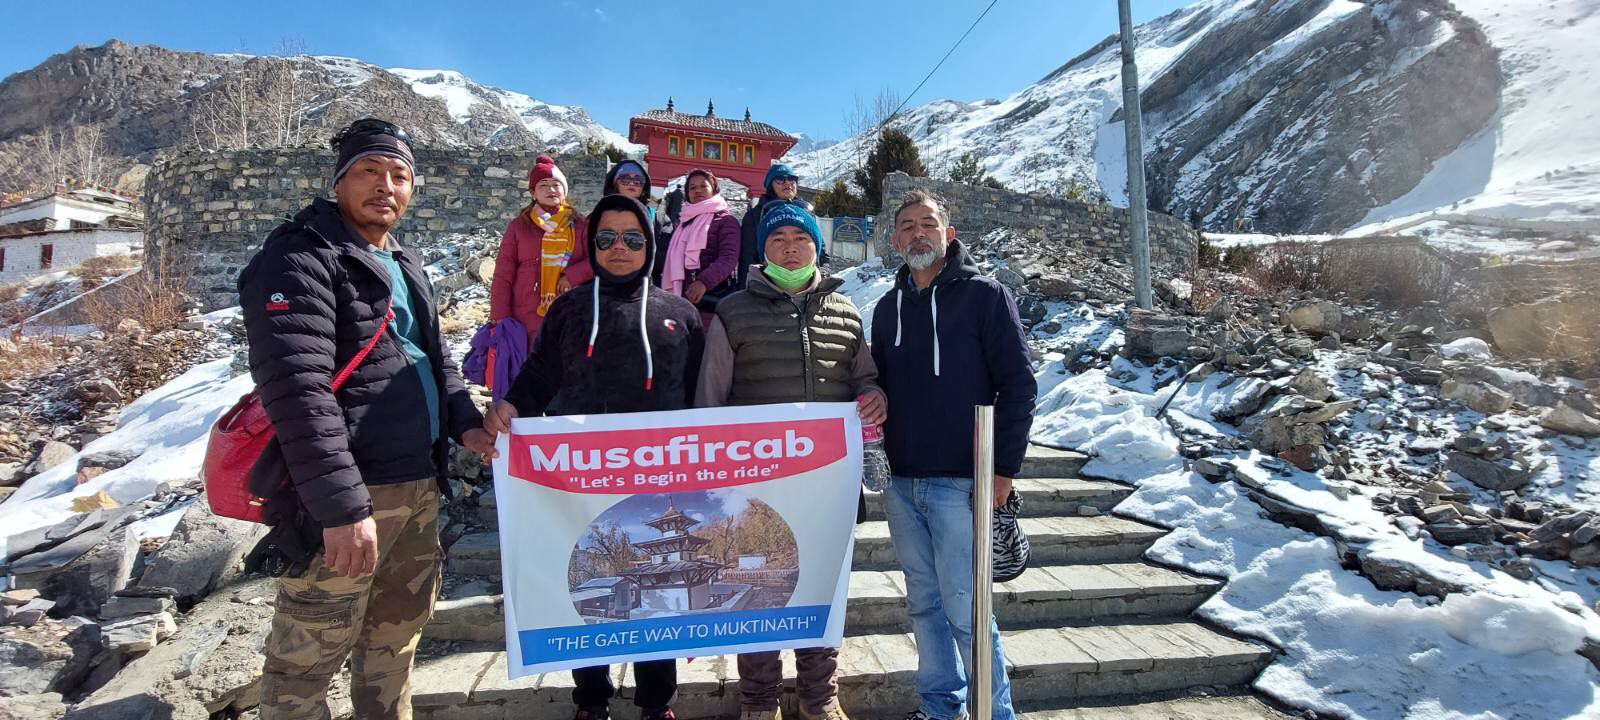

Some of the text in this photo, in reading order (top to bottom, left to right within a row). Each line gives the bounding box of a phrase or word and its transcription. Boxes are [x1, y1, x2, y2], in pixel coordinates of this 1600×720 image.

[529, 429, 815, 471] Musafircab
[569, 464, 779, 489] "Let's Begin the ride"
[547, 616, 817, 651] "THE GATE WAY TO MUKTINATH"
